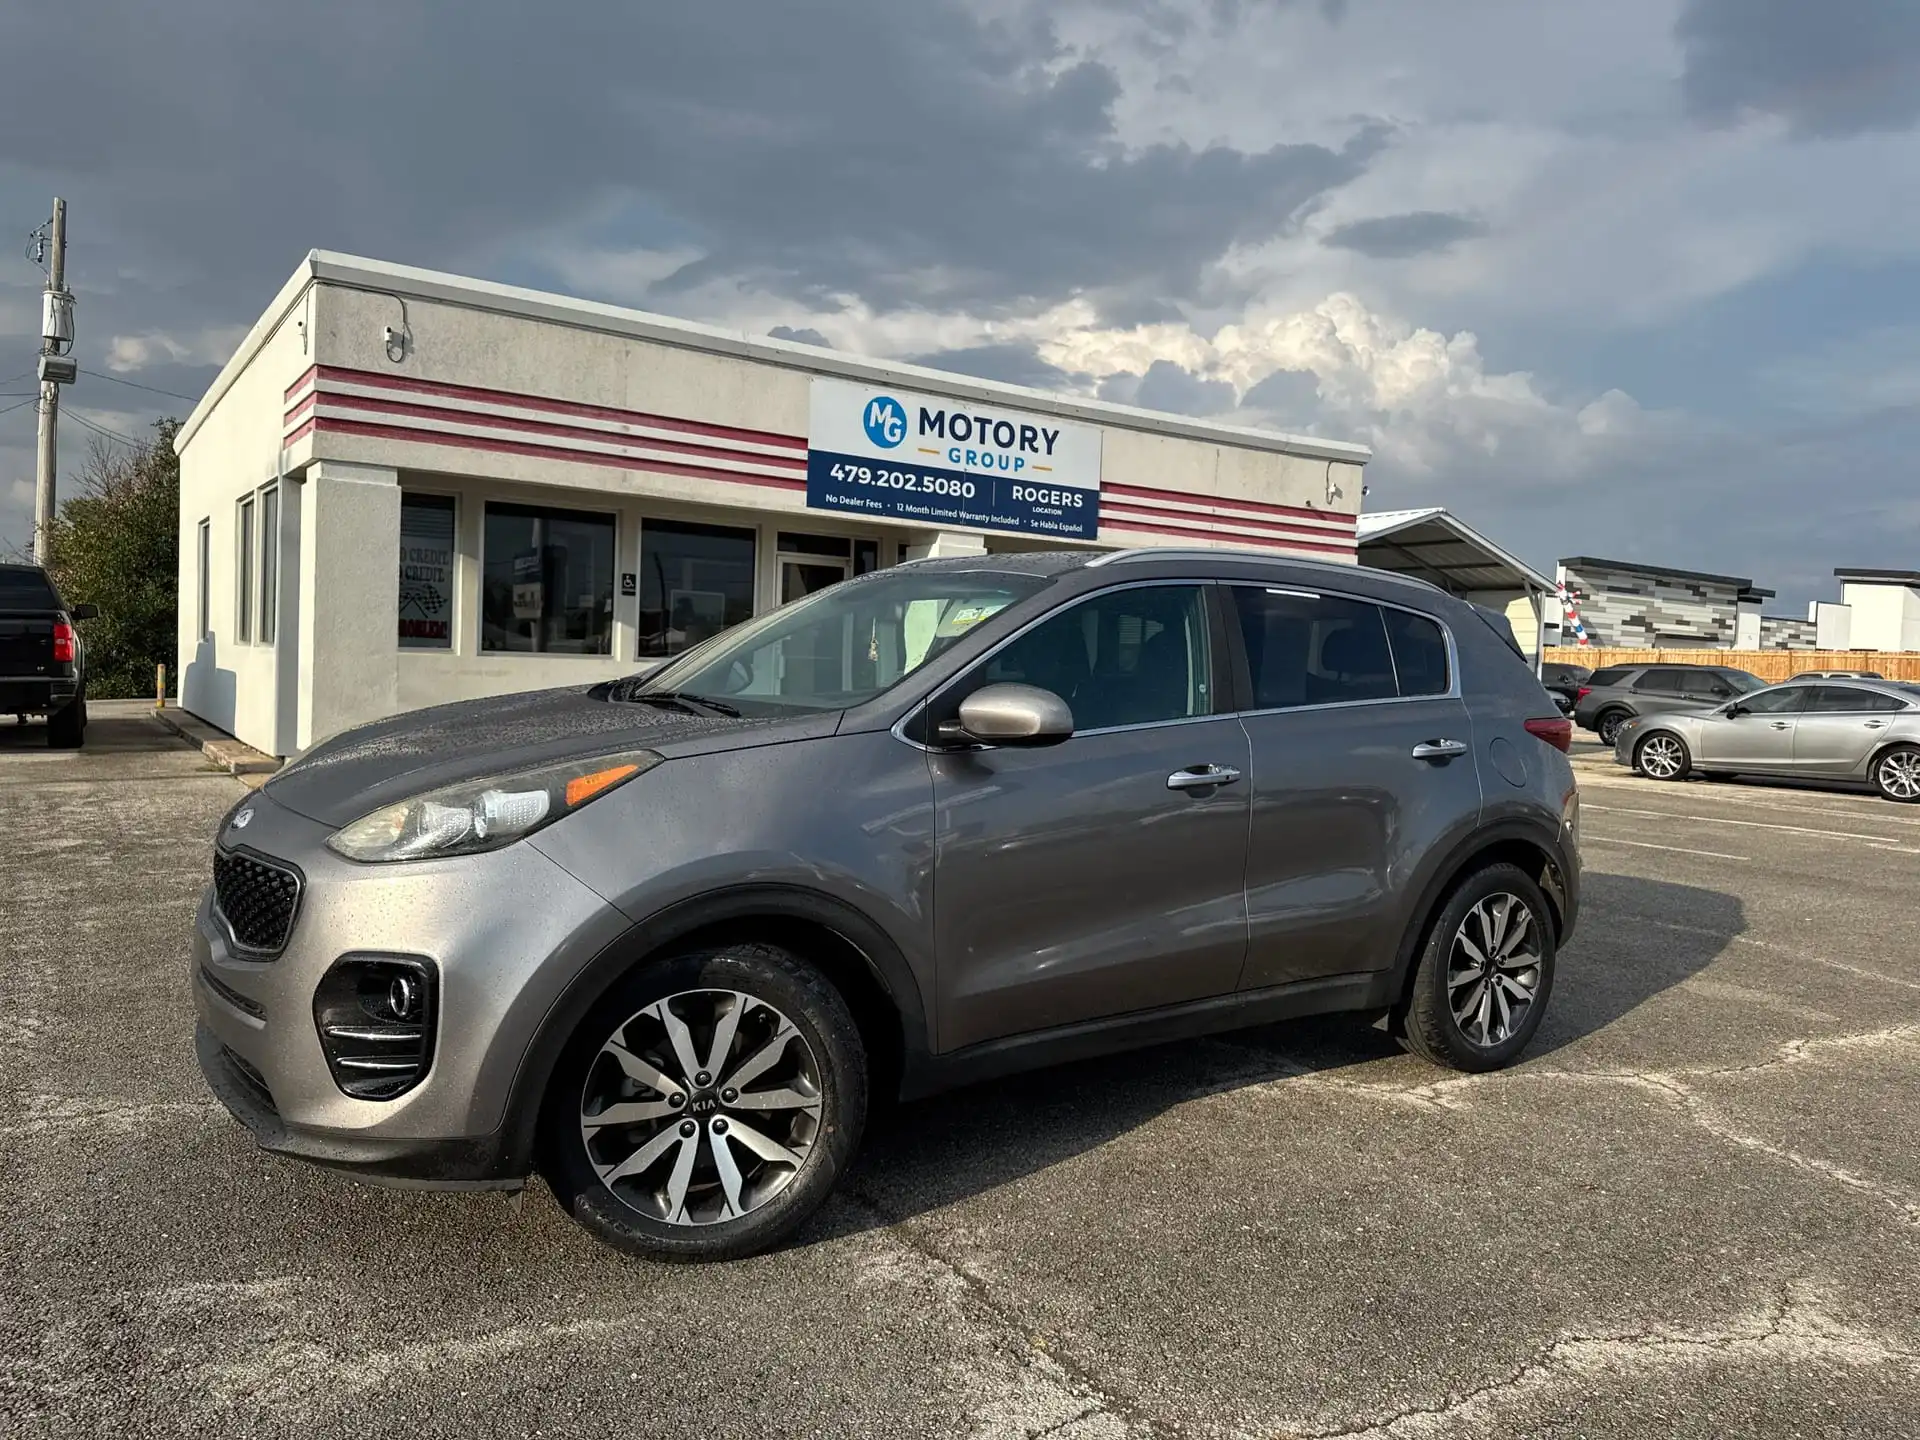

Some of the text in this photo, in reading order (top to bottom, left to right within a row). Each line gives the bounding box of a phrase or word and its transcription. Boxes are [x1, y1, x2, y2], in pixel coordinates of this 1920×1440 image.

[869, 402, 902, 443] MG
[919, 406, 1060, 456] MOTORY
[948, 447, 1025, 472] GROUP
[830, 463, 976, 499] 479.202.5080
[1012, 485, 1084, 508] ROGERS
[825, 493, 1083, 533] No Dealer Fees 12 Month Limited Warranty Included Se Habla Español
[1032, 506, 1062, 516] LOCATION
[409, 548, 449, 565] CREDIT
[405, 565, 445, 582] CREDIT
[692, 1099, 716, 1112] KIA
